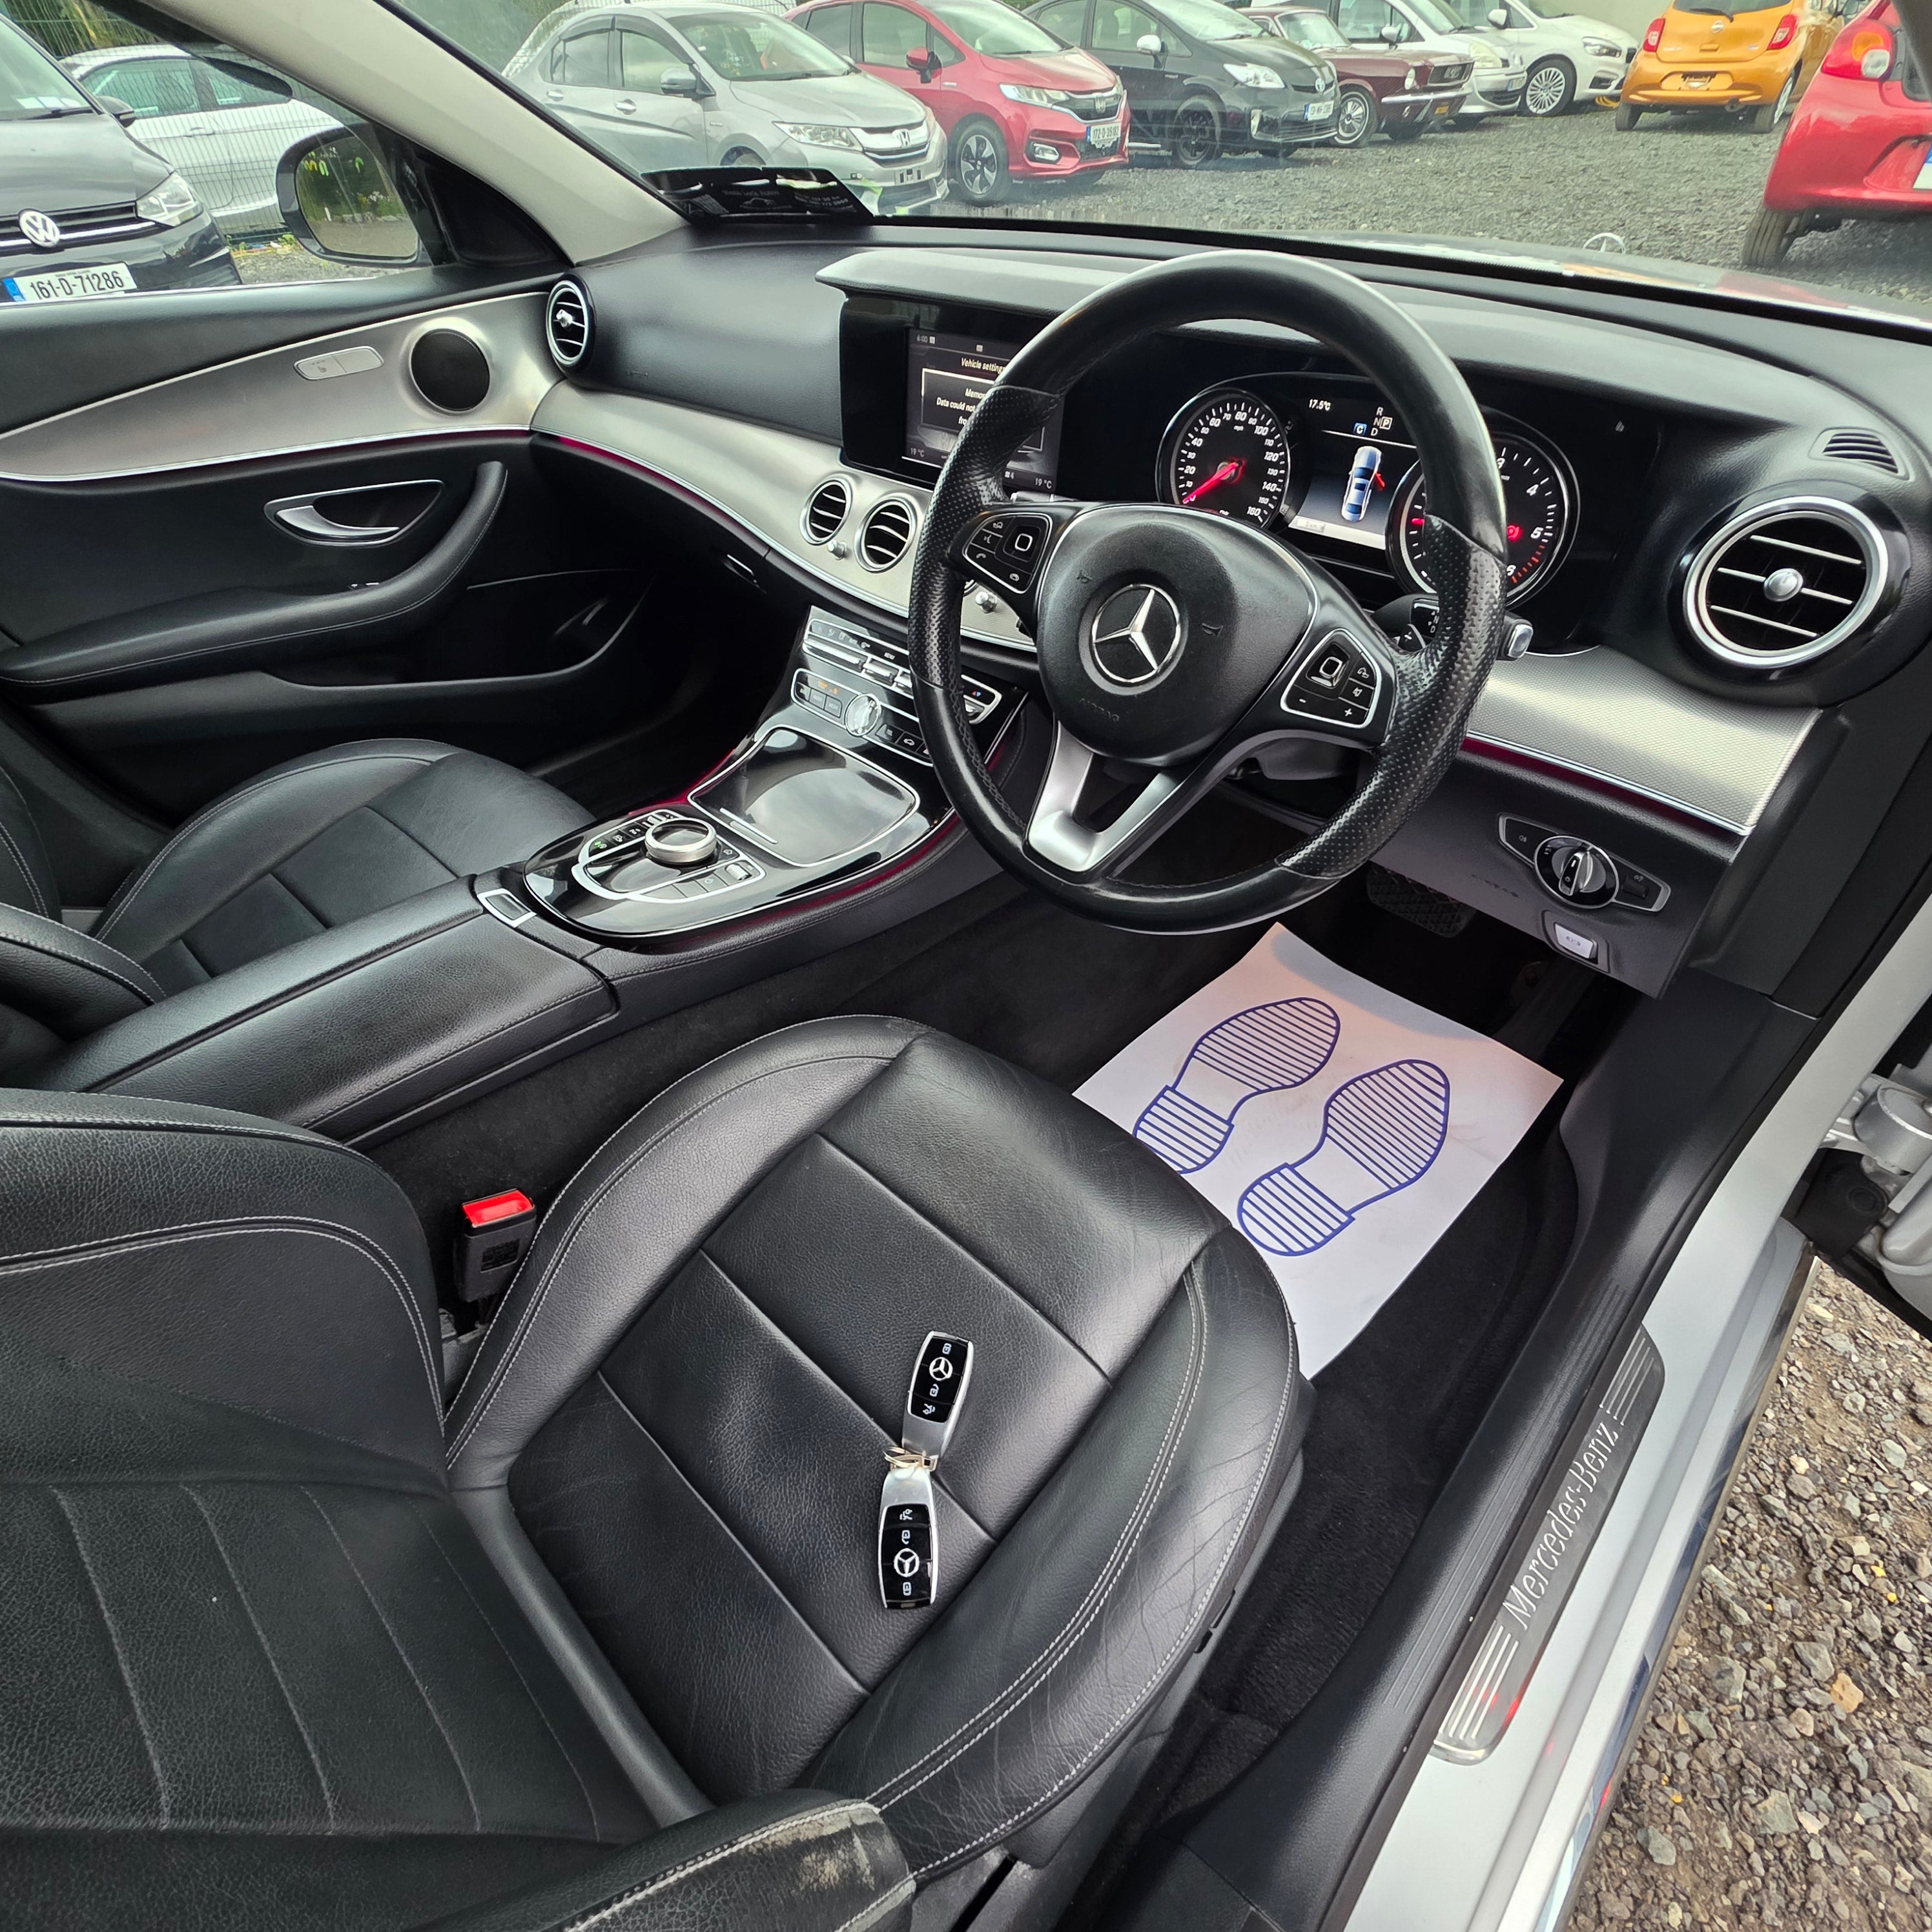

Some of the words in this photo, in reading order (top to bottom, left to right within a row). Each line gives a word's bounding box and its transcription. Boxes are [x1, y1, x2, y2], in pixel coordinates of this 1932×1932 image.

[30, 271, 125, 300] 161-D-71286
[961, 357, 982, 369] Vehicle
[936, 396, 949, 406] Data
[949, 400, 965, 411] could
[1235, 411, 1247, 421] 80
[1376, 407, 1384, 416] R
[958, 416, 968, 425] fro
[1209, 418, 1221, 427] 60
[1373, 418, 1381, 426] N
[1254, 426, 1269, 436] 100
[1191, 438, 1203, 447] 40
[1264, 438, 1274, 447] 110
[1264, 451, 1279, 462] 120
[1184, 465, 1196, 474] 20
[1267, 468, 1278, 476] 130
[1262, 481, 1277, 492] 140
[1526, 484, 1539, 496] 4
[1247, 506, 1262, 516] 160
[1530, 527, 1544, 539] 5
[1502, 1422, 1619, 1631] Mercedes-Benz
